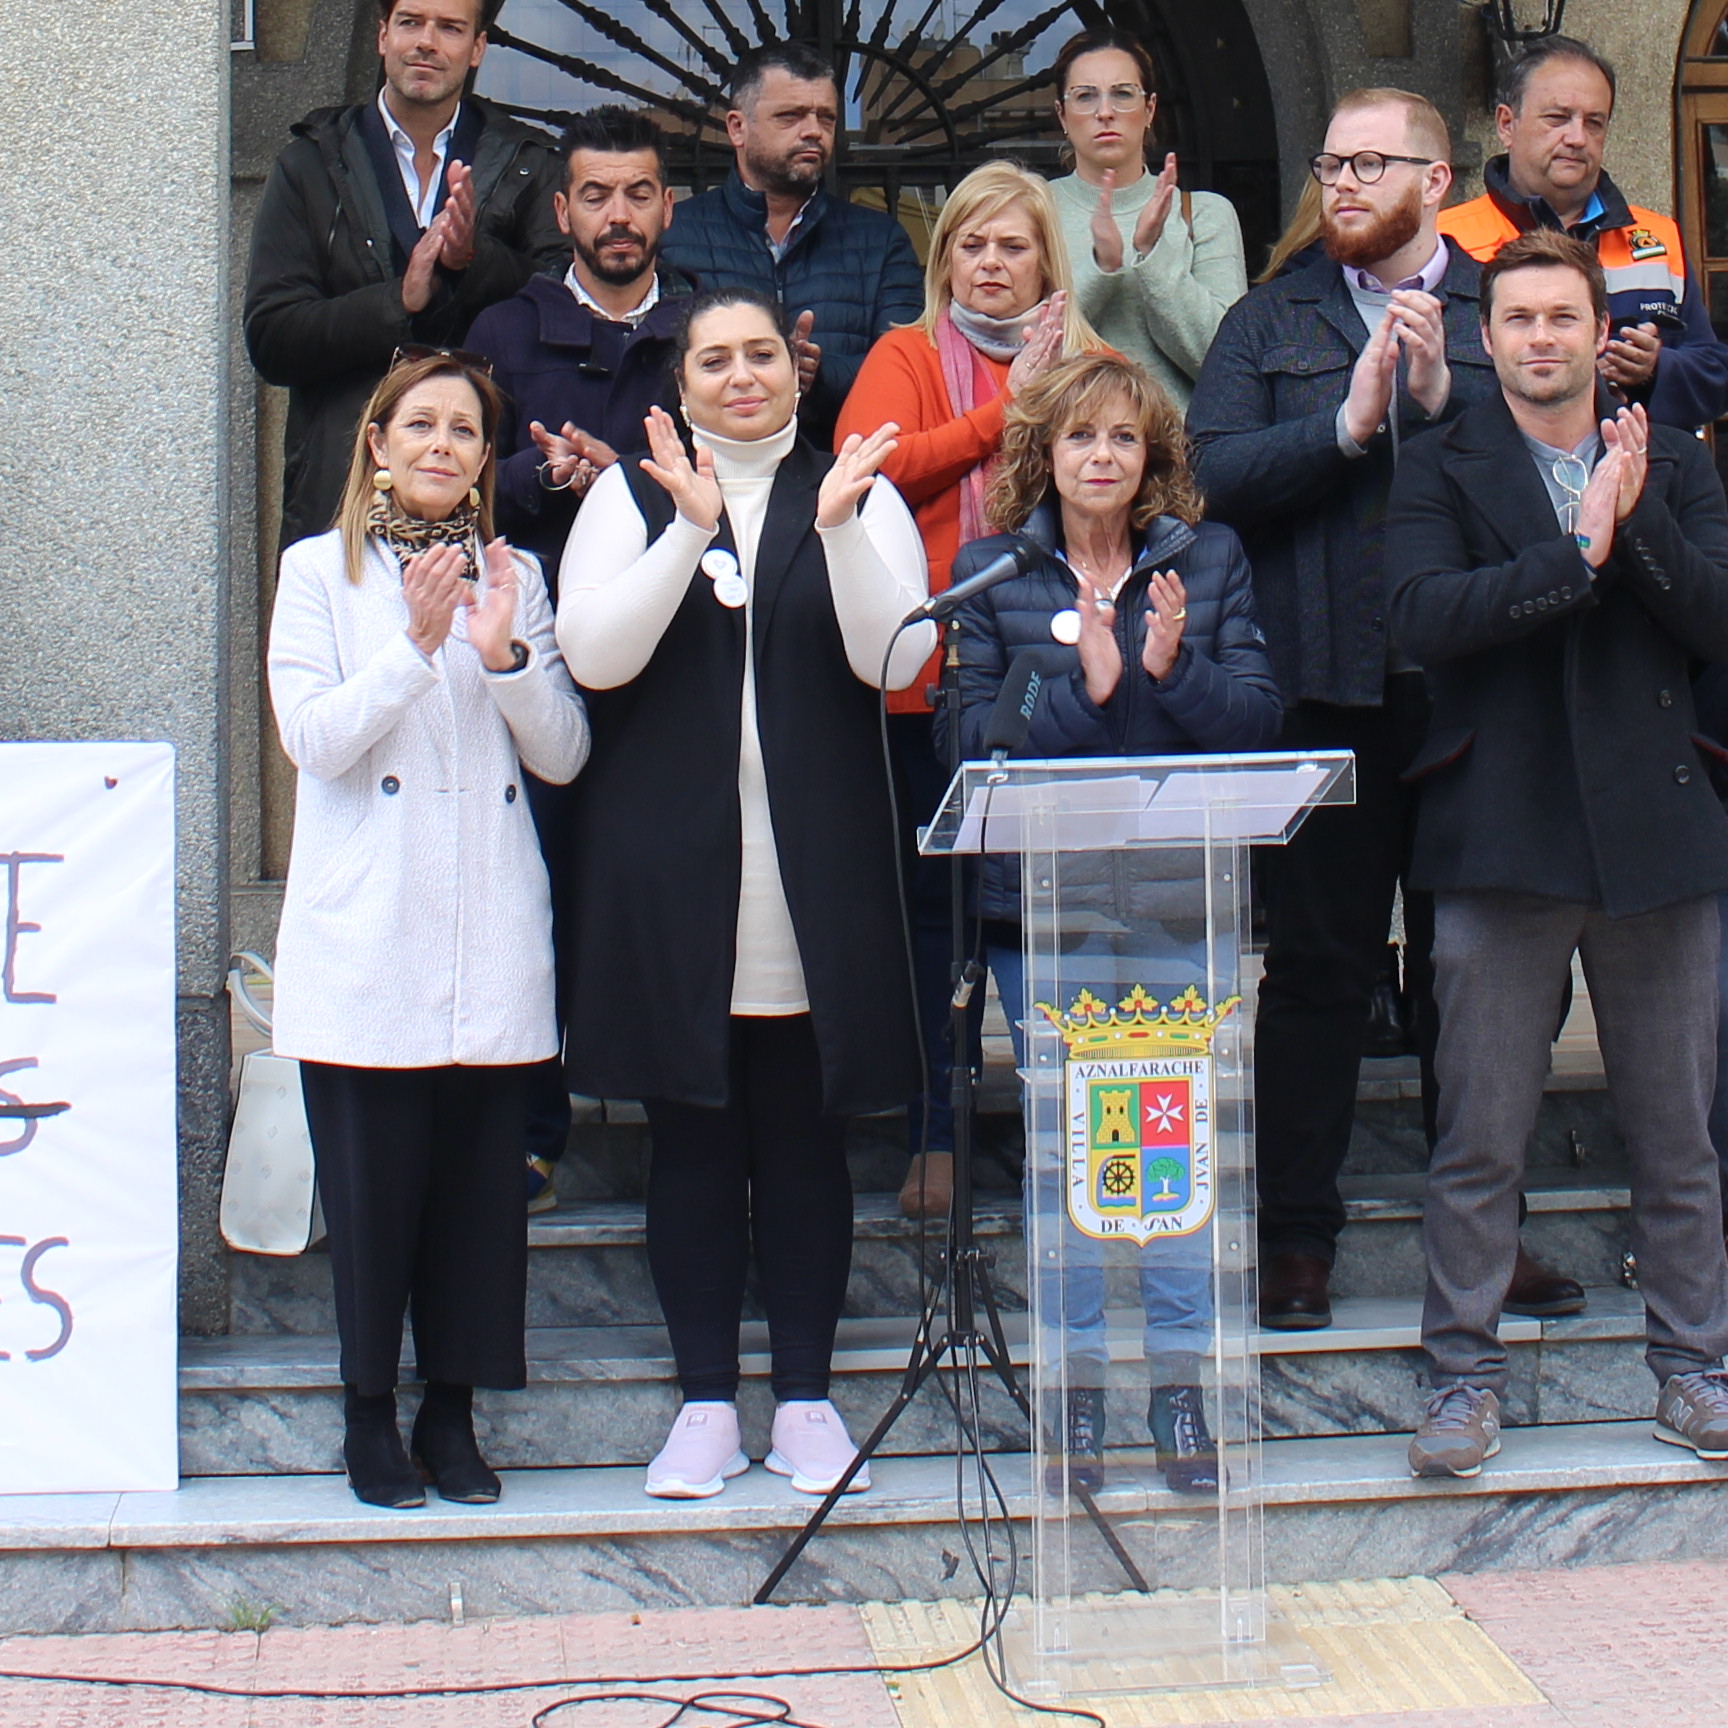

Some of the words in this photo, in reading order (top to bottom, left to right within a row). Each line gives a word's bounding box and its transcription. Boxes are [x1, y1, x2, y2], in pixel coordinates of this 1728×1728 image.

[1075, 1060, 1204, 1079] AZNALFARACHE
[1195, 1098, 1208, 1123] DE
[1072, 1112, 1086, 1188] VILLA
[1100, 1219, 1125, 1233] DE
[1144, 1216, 1183, 1232] SAN
